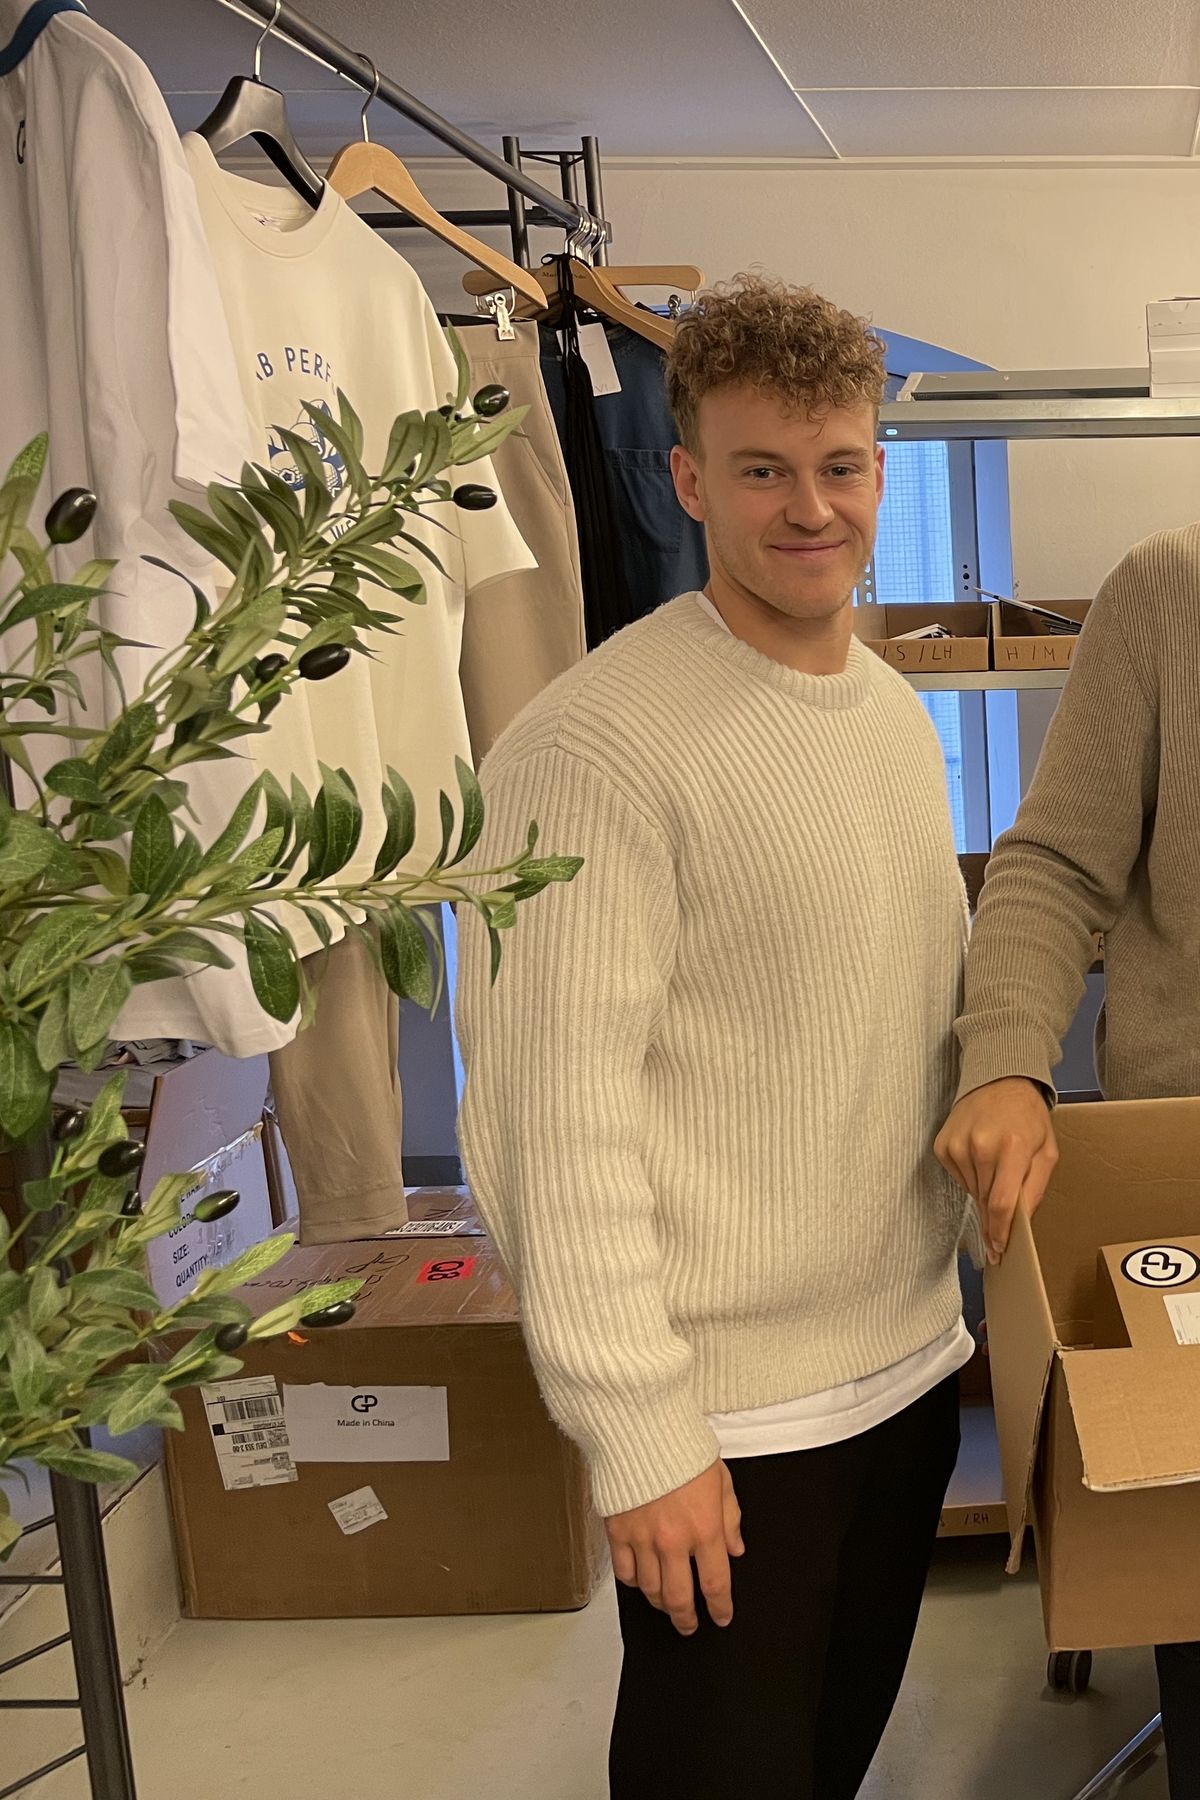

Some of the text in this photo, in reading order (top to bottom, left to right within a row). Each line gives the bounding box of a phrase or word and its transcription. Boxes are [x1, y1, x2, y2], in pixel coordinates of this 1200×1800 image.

[336, 1418, 396, 1427] Made in China
